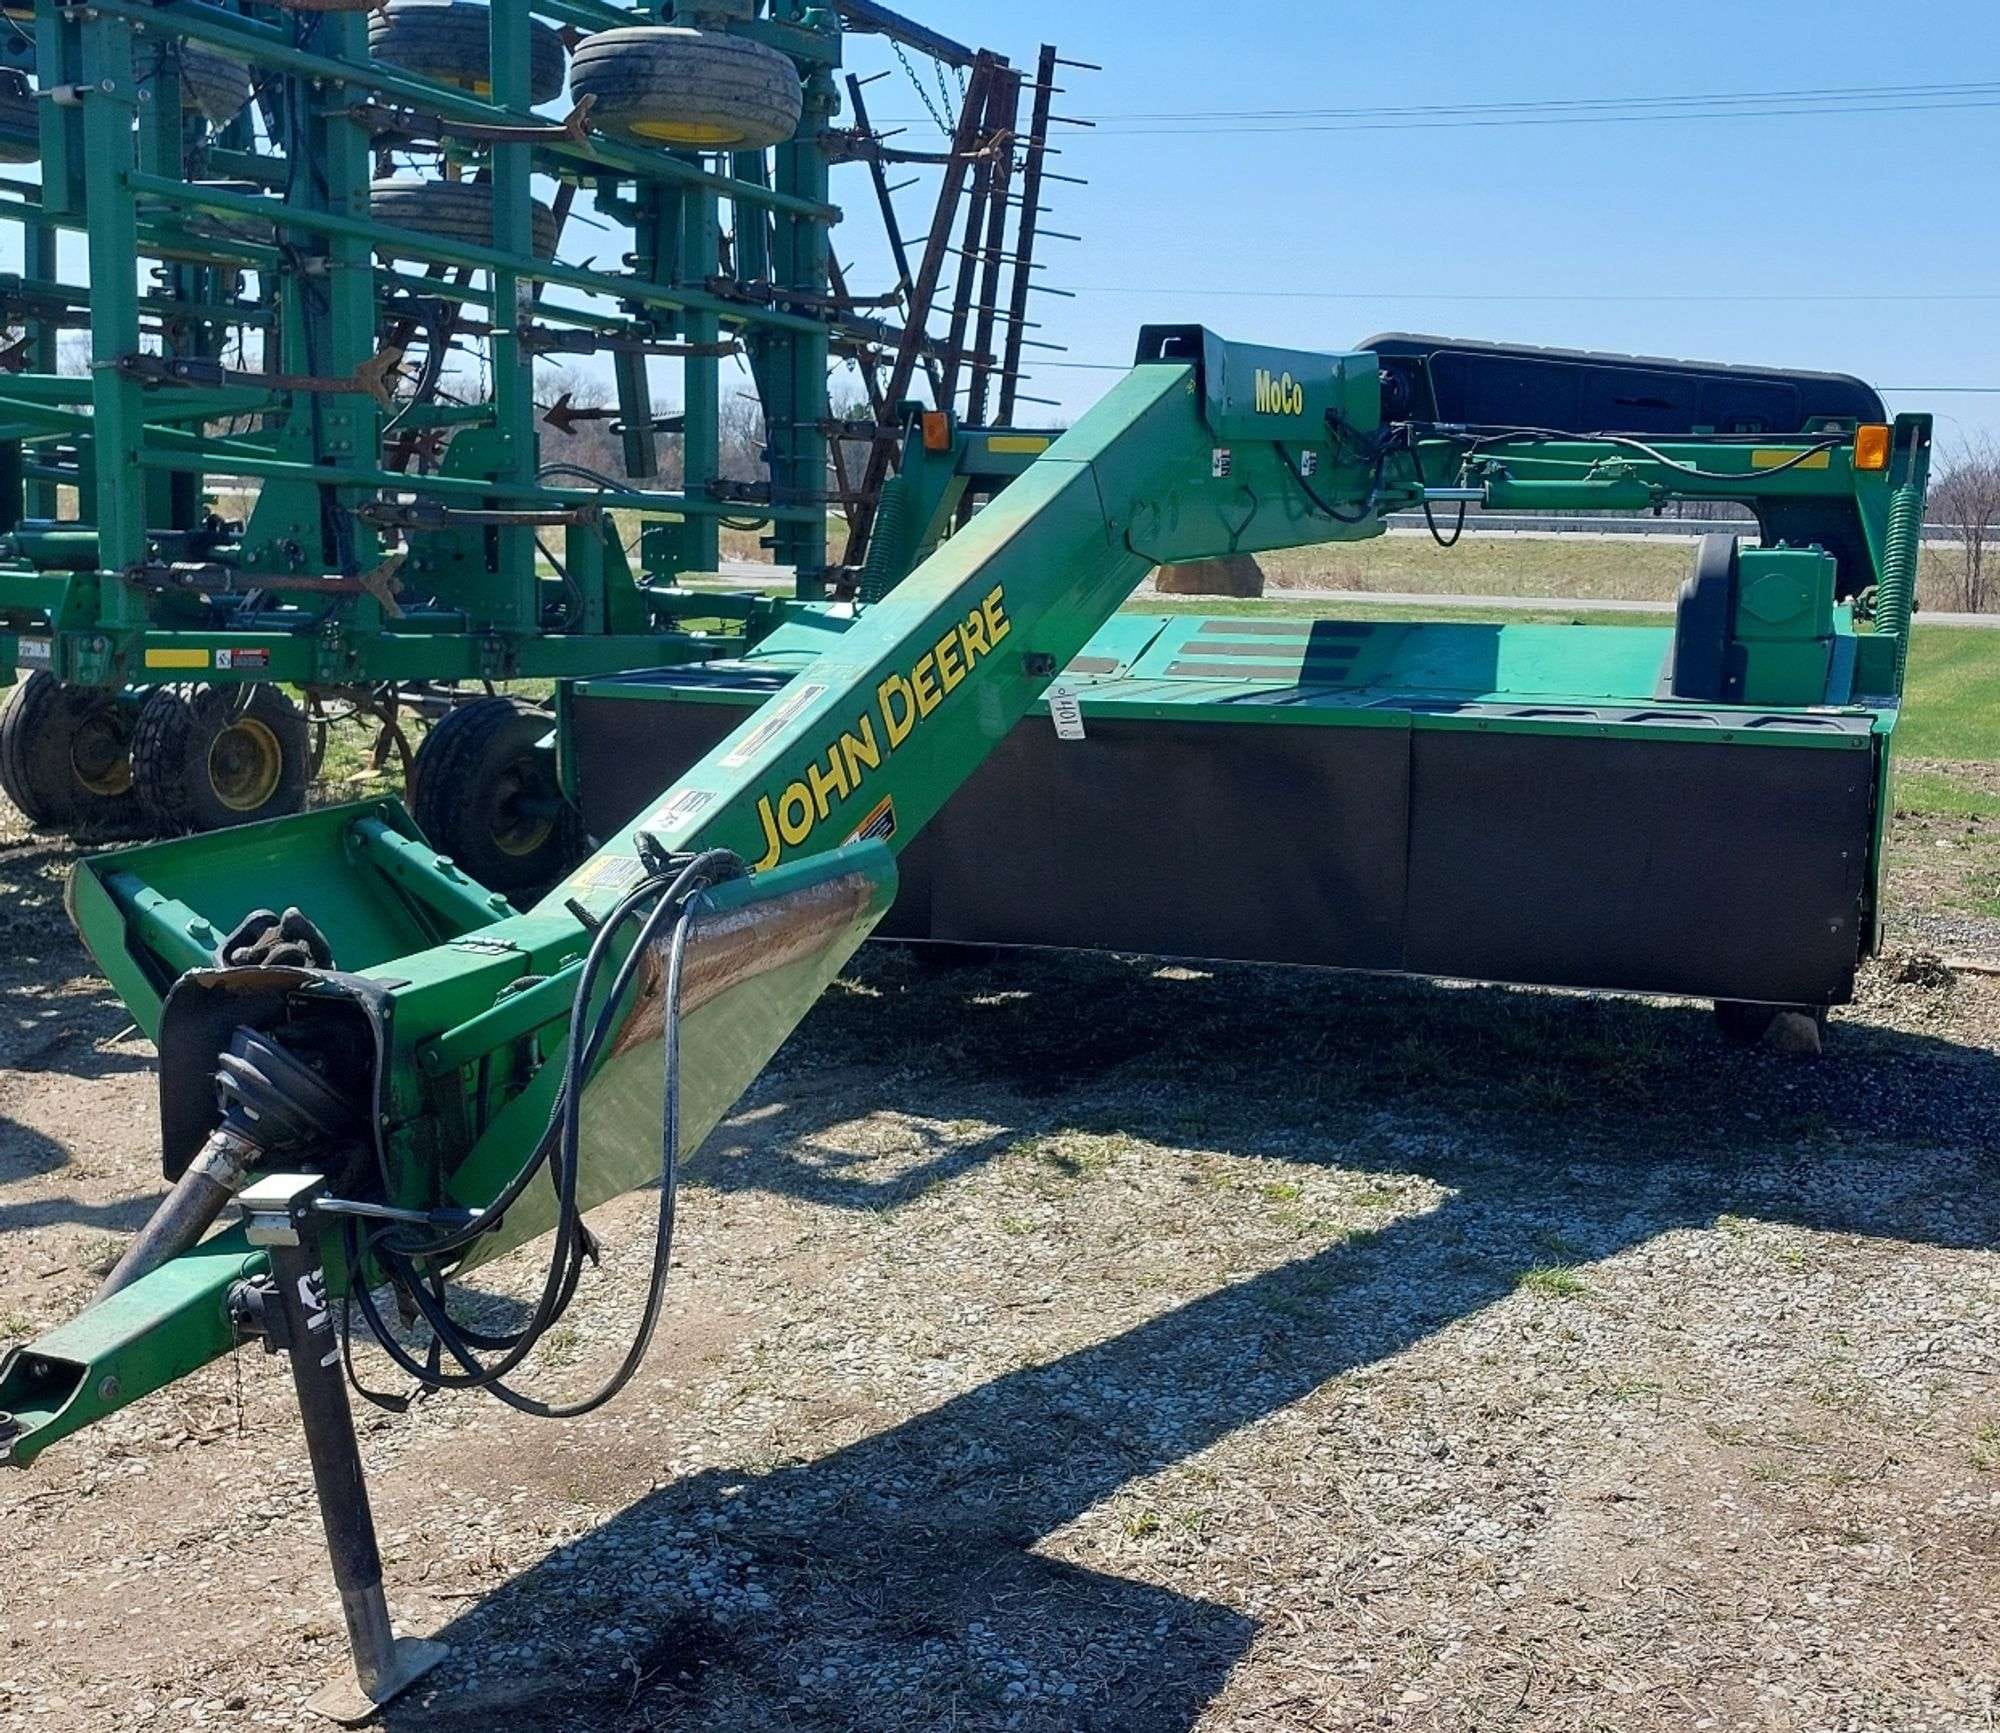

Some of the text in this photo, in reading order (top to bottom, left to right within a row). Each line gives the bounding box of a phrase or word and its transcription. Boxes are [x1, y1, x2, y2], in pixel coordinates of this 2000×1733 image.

[1255, 368, 1303, 415] MoCo
[755, 714, 881, 872] JOHN
[879, 585, 1010, 749] DEERE
